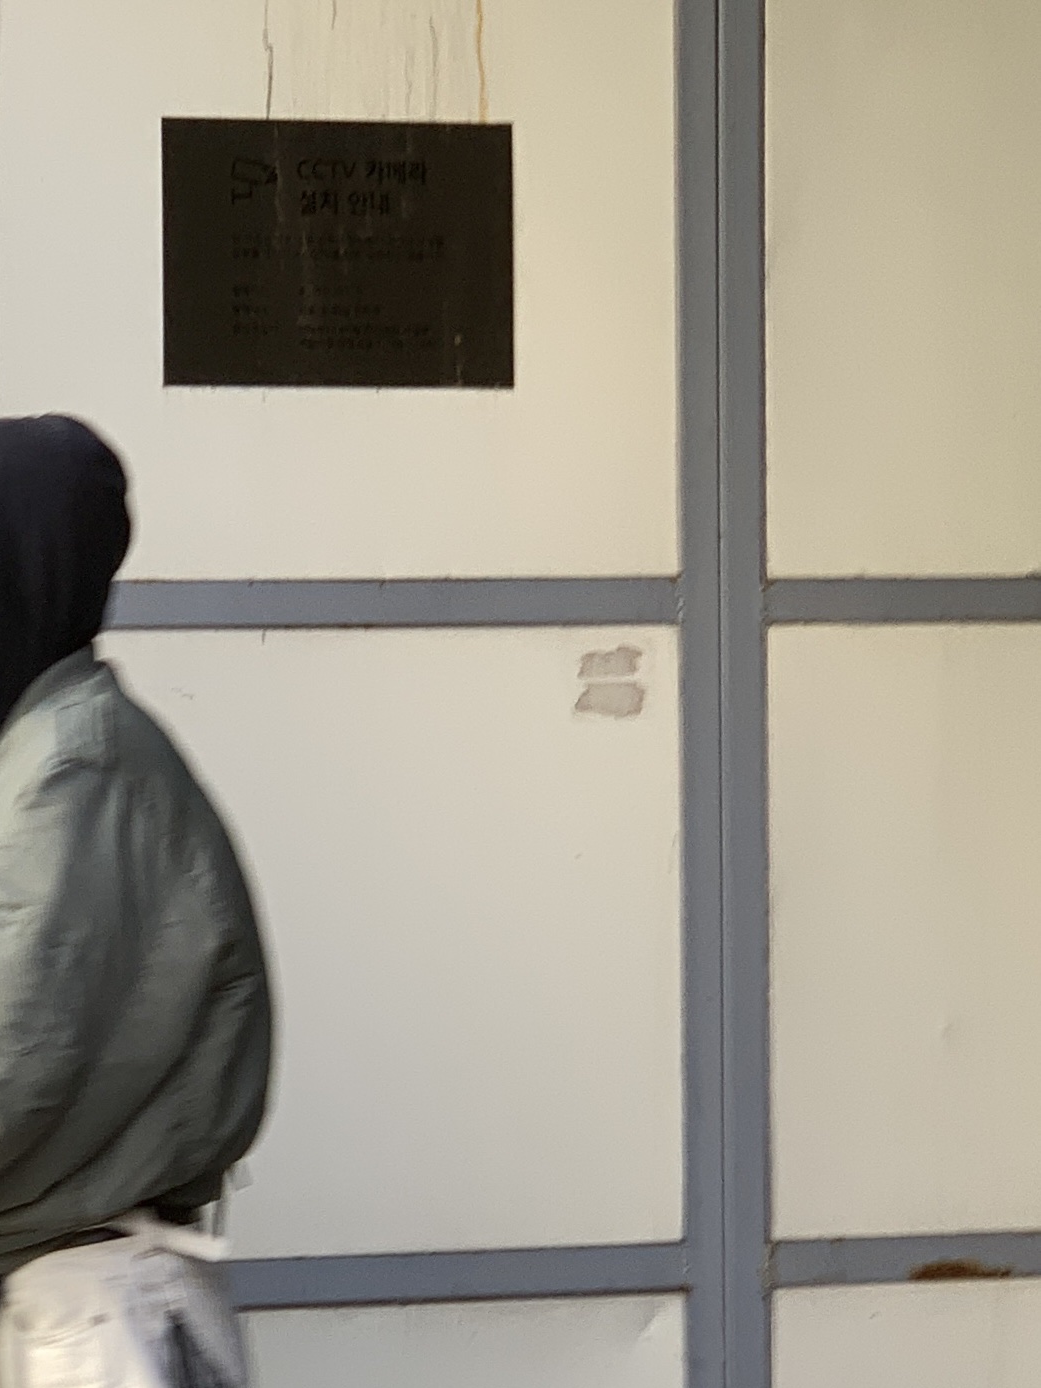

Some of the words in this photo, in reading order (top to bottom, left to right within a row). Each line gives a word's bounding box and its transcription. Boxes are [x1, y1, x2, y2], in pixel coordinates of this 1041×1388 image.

[296, 158, 355, 181] CCTV
[365, 158, 427, 186] 카메라
[300, 189, 339, 216] 설치
[347, 190, 391, 217] 안내
